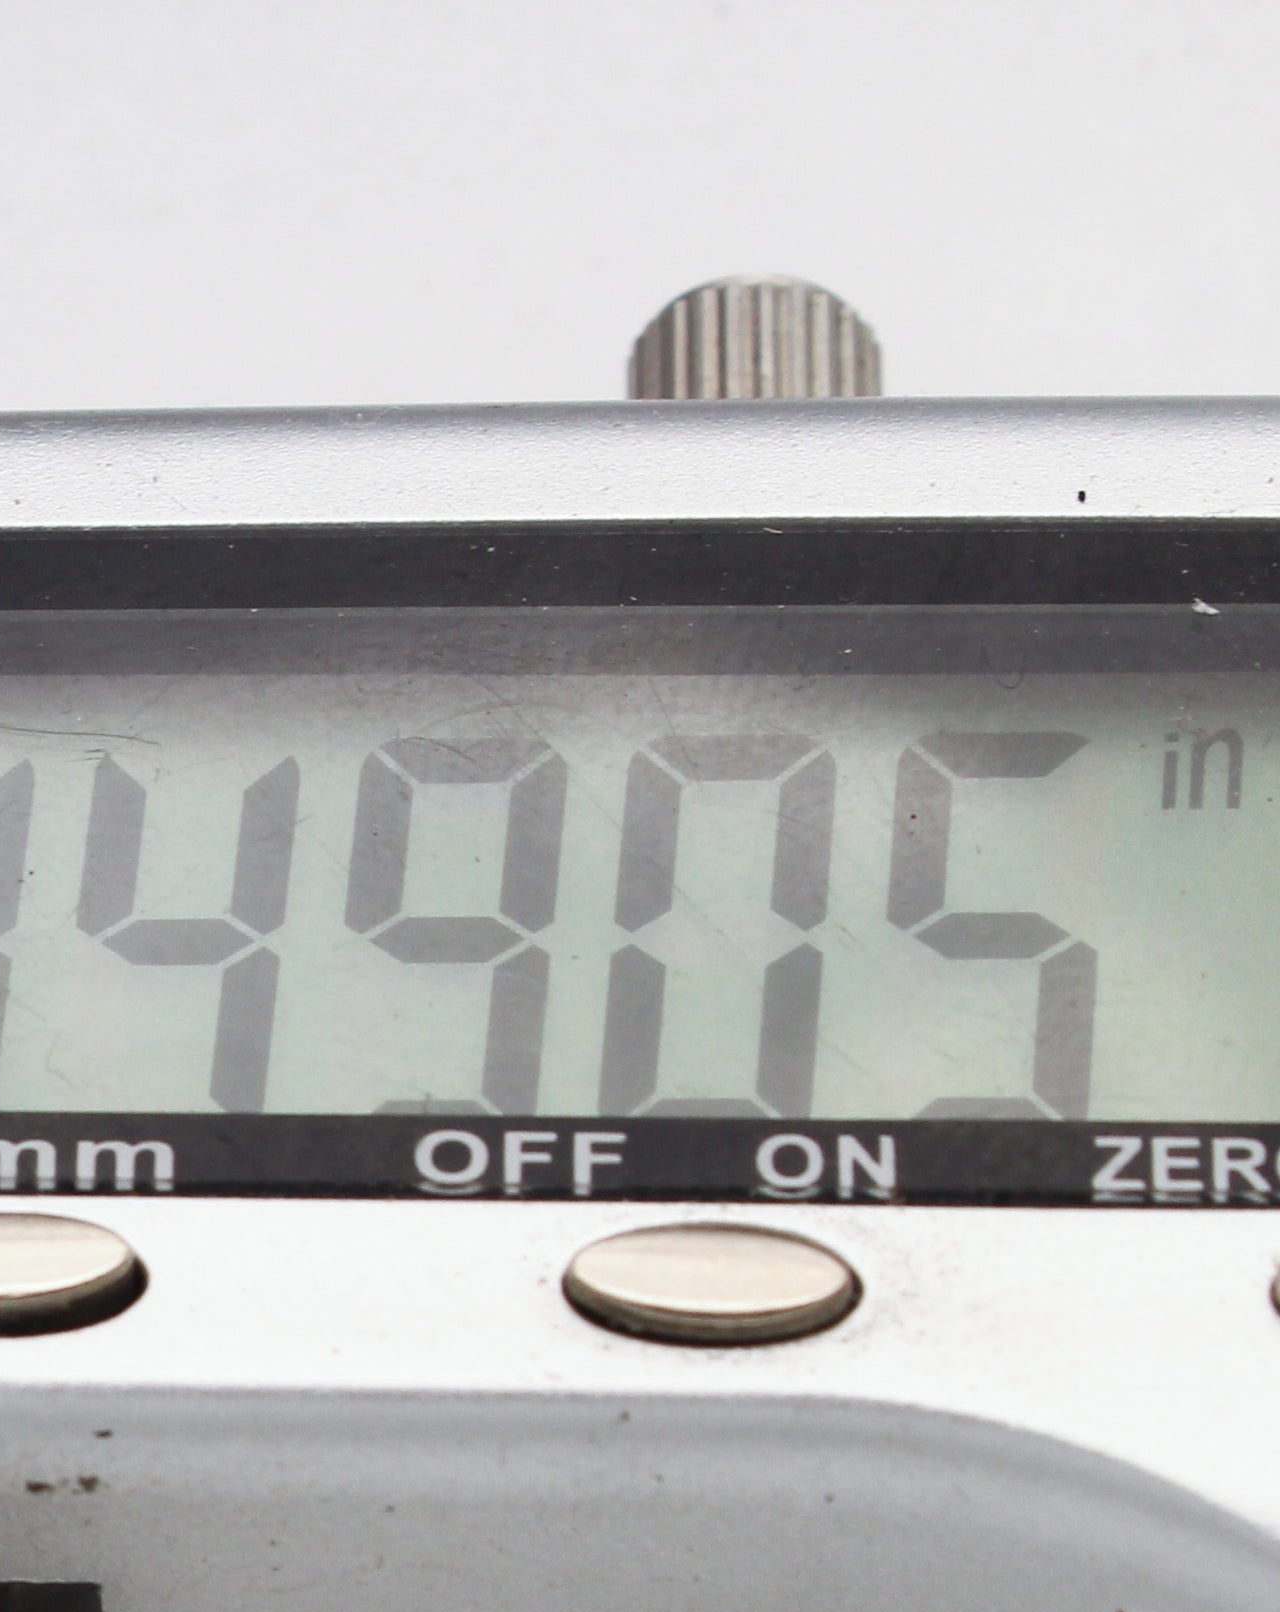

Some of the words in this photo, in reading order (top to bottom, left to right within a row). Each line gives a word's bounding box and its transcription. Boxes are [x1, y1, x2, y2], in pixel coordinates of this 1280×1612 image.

[1162, 728, 1244, 810] in
[414, 1130, 628, 1191] OFF
[756, 1133, 897, 1191] ON
[1092, 1136, 1279, 1194] ZER
